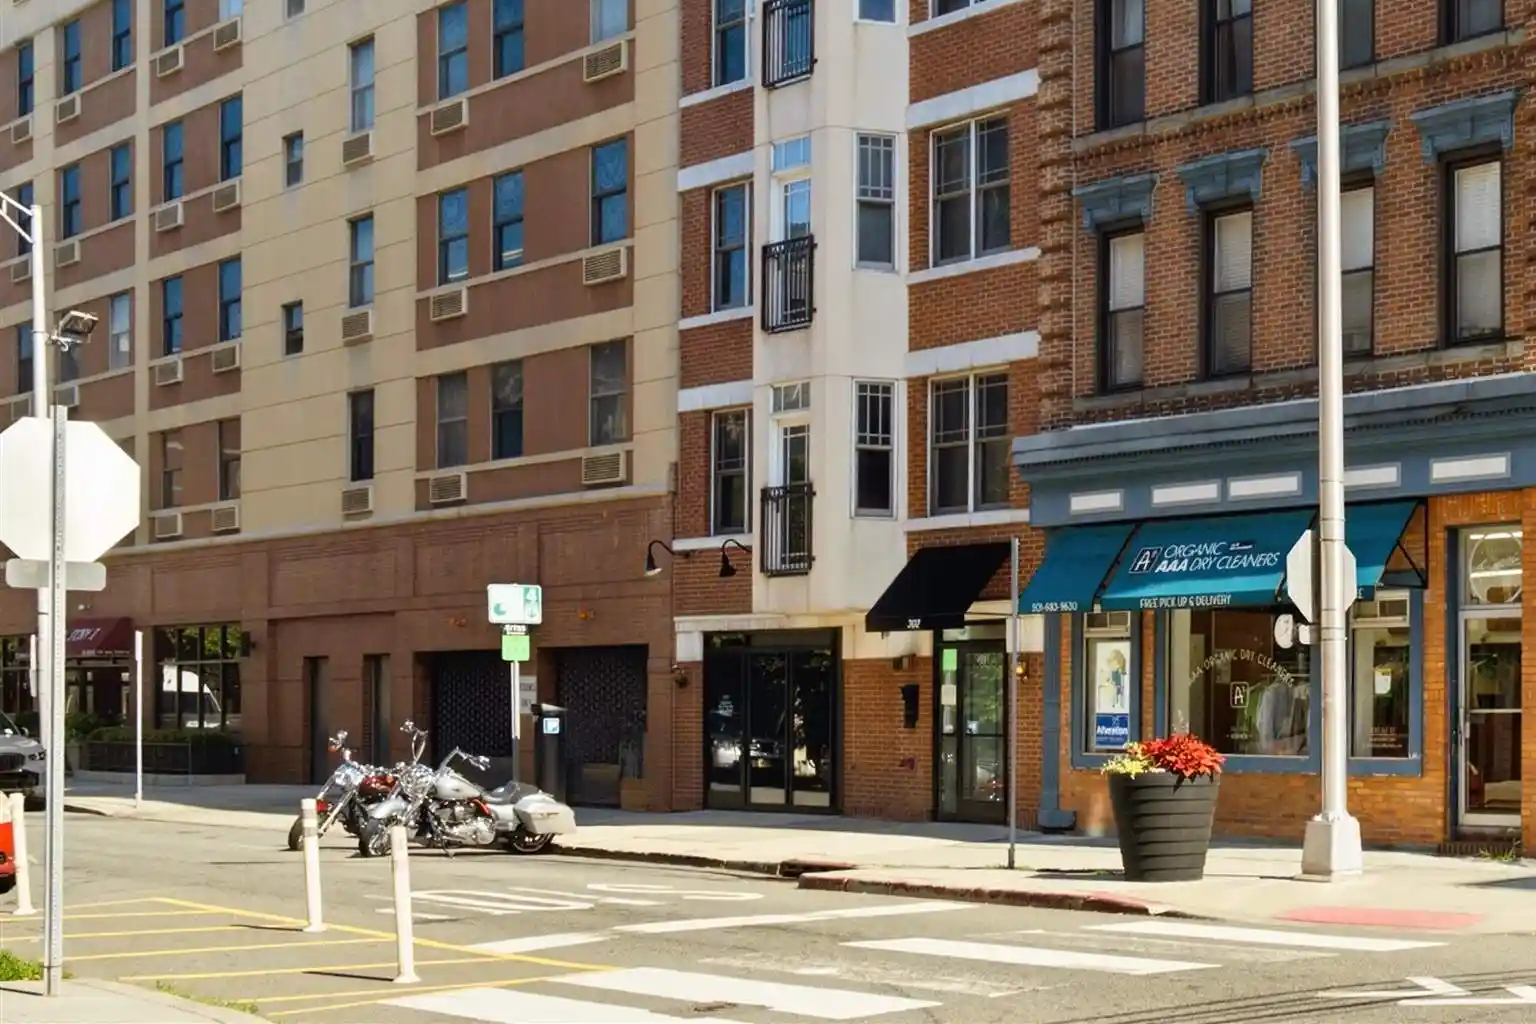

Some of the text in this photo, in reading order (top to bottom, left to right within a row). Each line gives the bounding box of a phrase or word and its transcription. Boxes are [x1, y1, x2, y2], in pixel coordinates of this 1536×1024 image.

[1163, 541, 1228, 558] ORGANIC
[1154, 552, 1281, 573] AAA DRY CLEANERS
[1139, 597, 1158, 609] FREE
[1159, 596, 1176, 608] PICK
[1177, 595, 1188, 607] UP
[1196, 594, 1232, 606] DELIVERY
